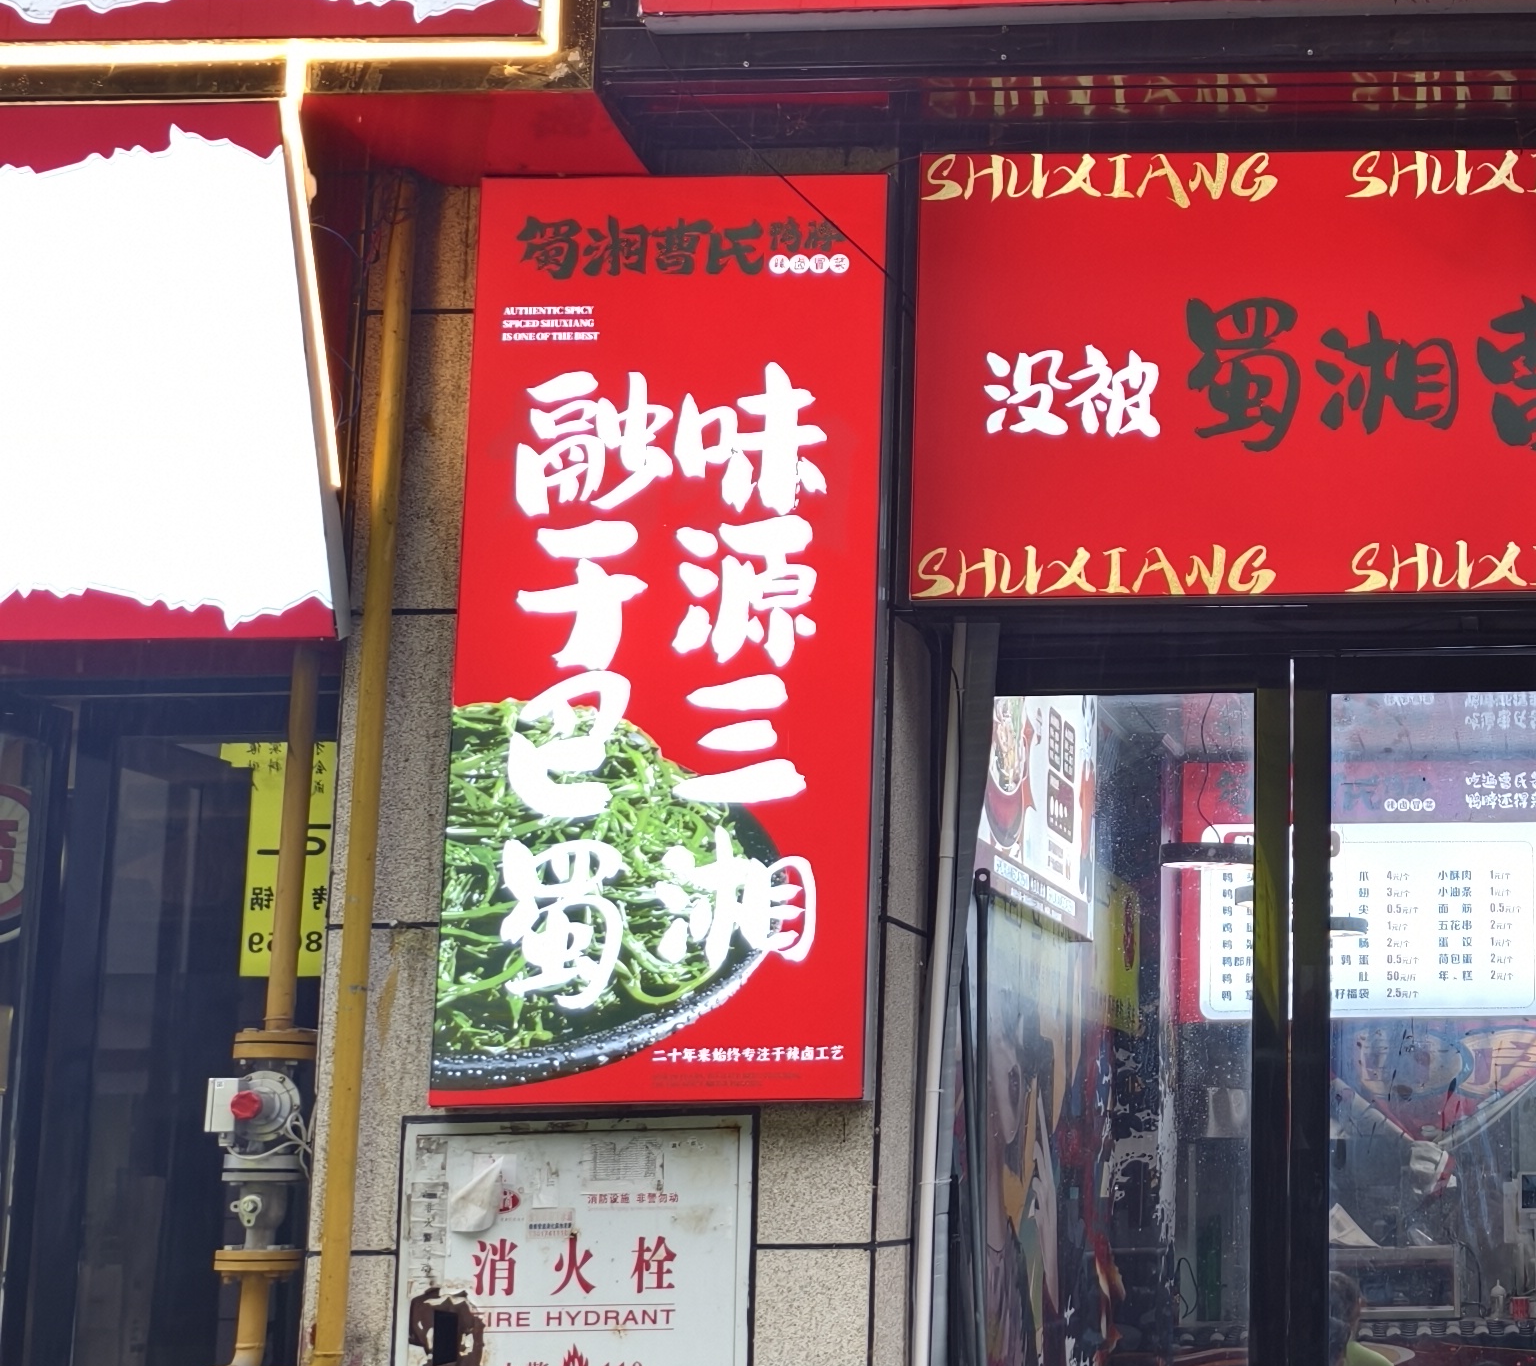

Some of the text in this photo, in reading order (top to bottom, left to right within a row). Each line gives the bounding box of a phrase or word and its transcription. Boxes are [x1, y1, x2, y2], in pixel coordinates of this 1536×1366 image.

[921, 152, 1279, 209] SHUXIANG
[517, 215, 764, 281] 蜀湘曹氏
[503, 305, 595, 316] AUTHENTIC SPICY
[502, 318, 595, 328] SPICED SHUXIANG
[502, 331, 601, 341] IS ONE OF THE BEST
[982, 344, 1161, 438] 没被
[913, 544, 1277, 598] SHUXIANG
[651, 1045, 844, 1063] 二十年来始终专注于辣卤工艺
[587, 1192, 680, 1204] 消防设施 非警勿动
[471, 1235, 678, 1297] 消火栓
[545, 1308, 677, 1326] HYDRANT
